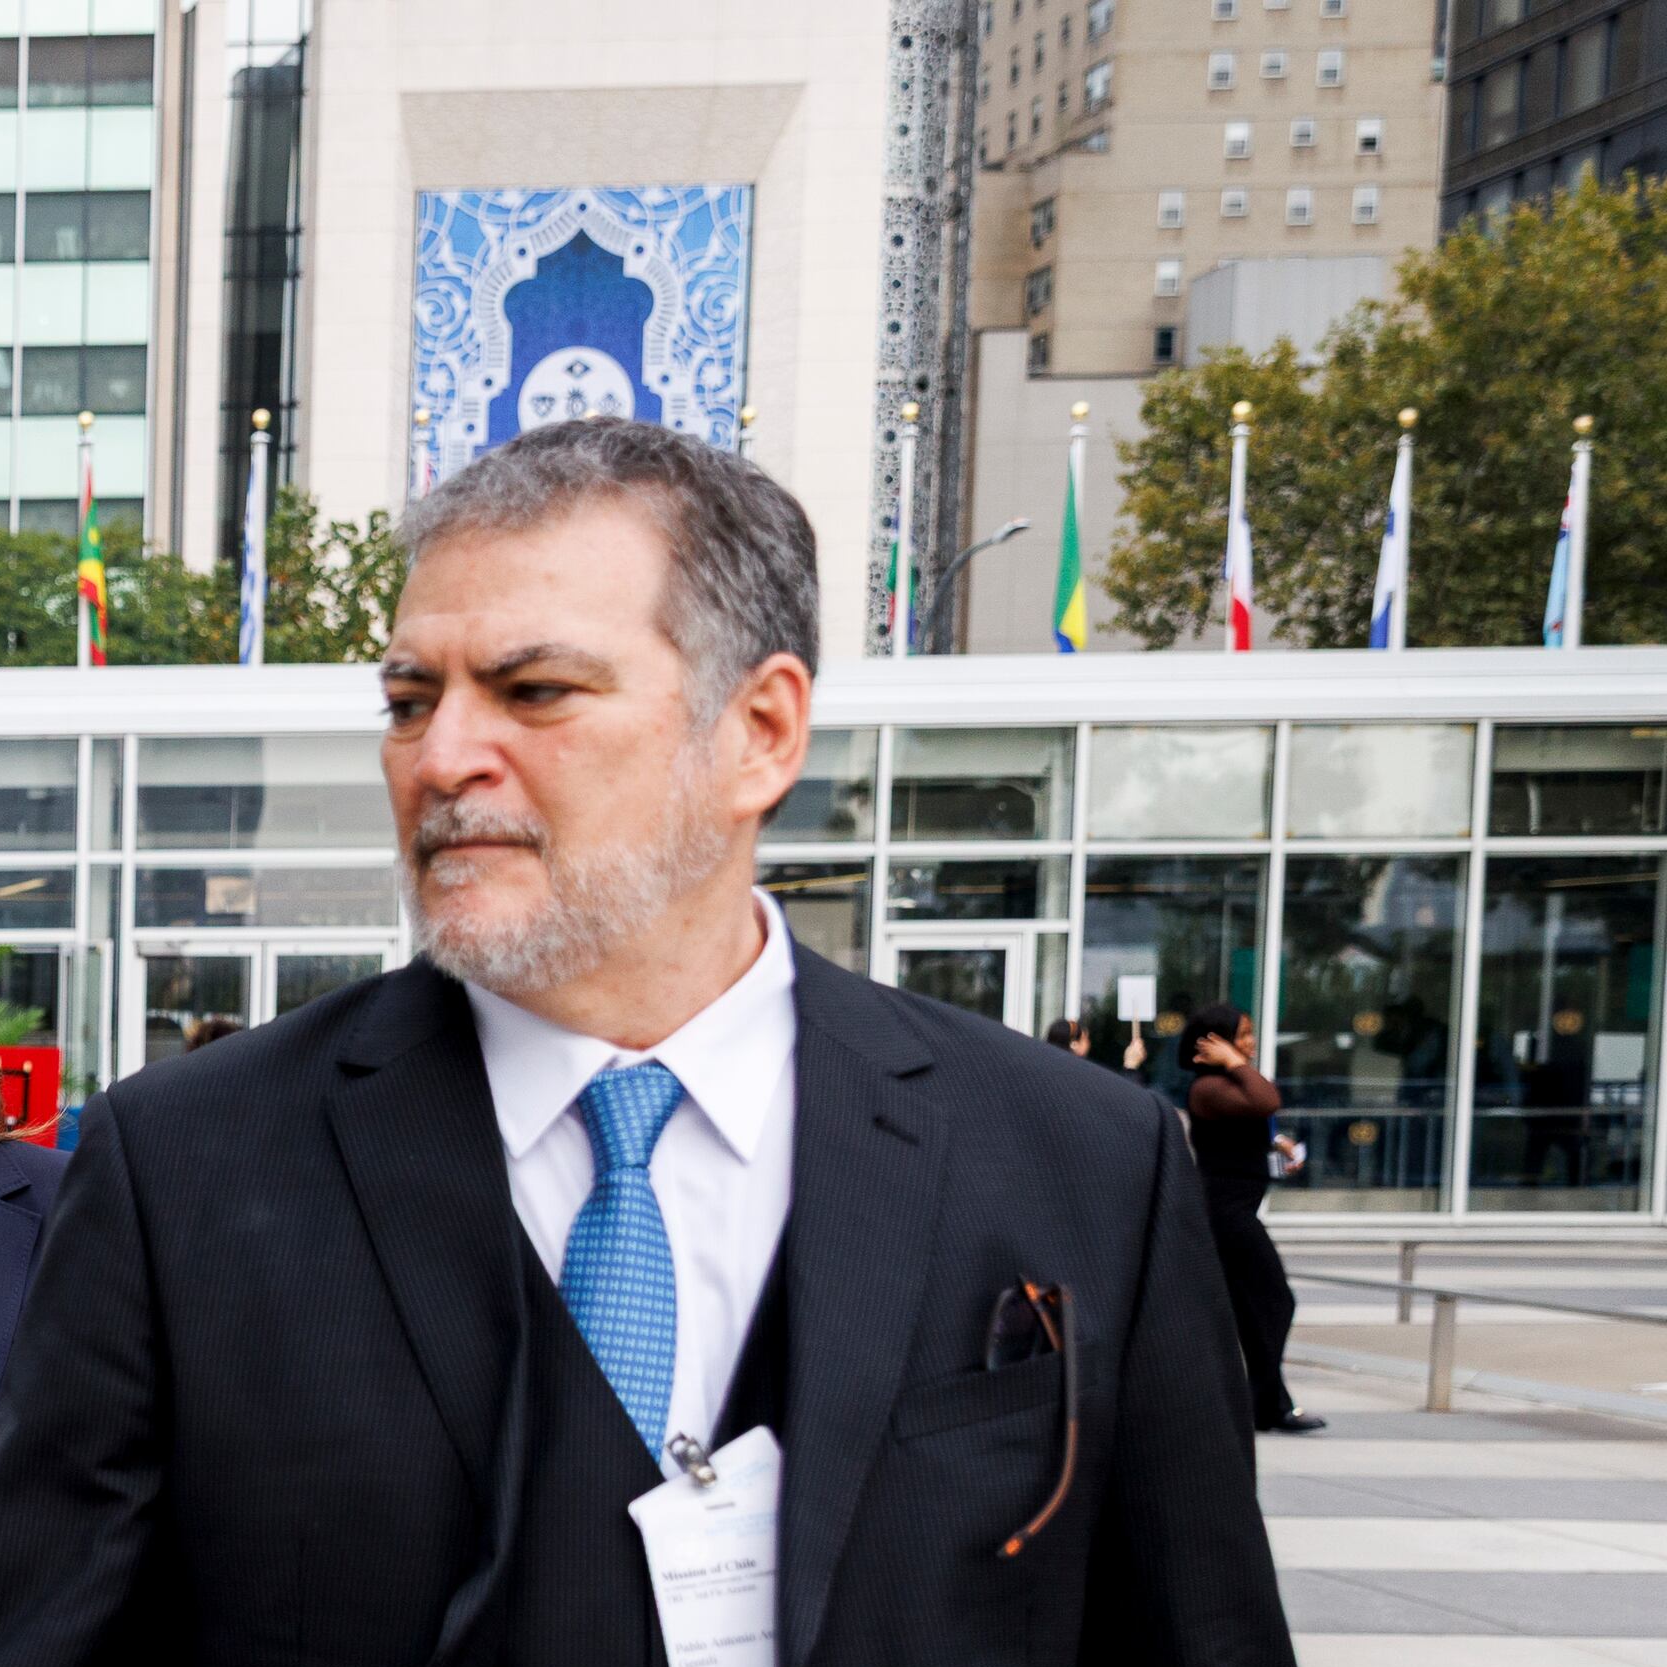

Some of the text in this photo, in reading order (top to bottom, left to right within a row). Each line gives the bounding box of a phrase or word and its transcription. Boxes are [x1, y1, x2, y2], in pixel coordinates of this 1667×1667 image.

[661, 1567, 707, 1582] Mission
[710, 1564, 721, 1574] of
[725, 1557, 757, 1571] Chile
